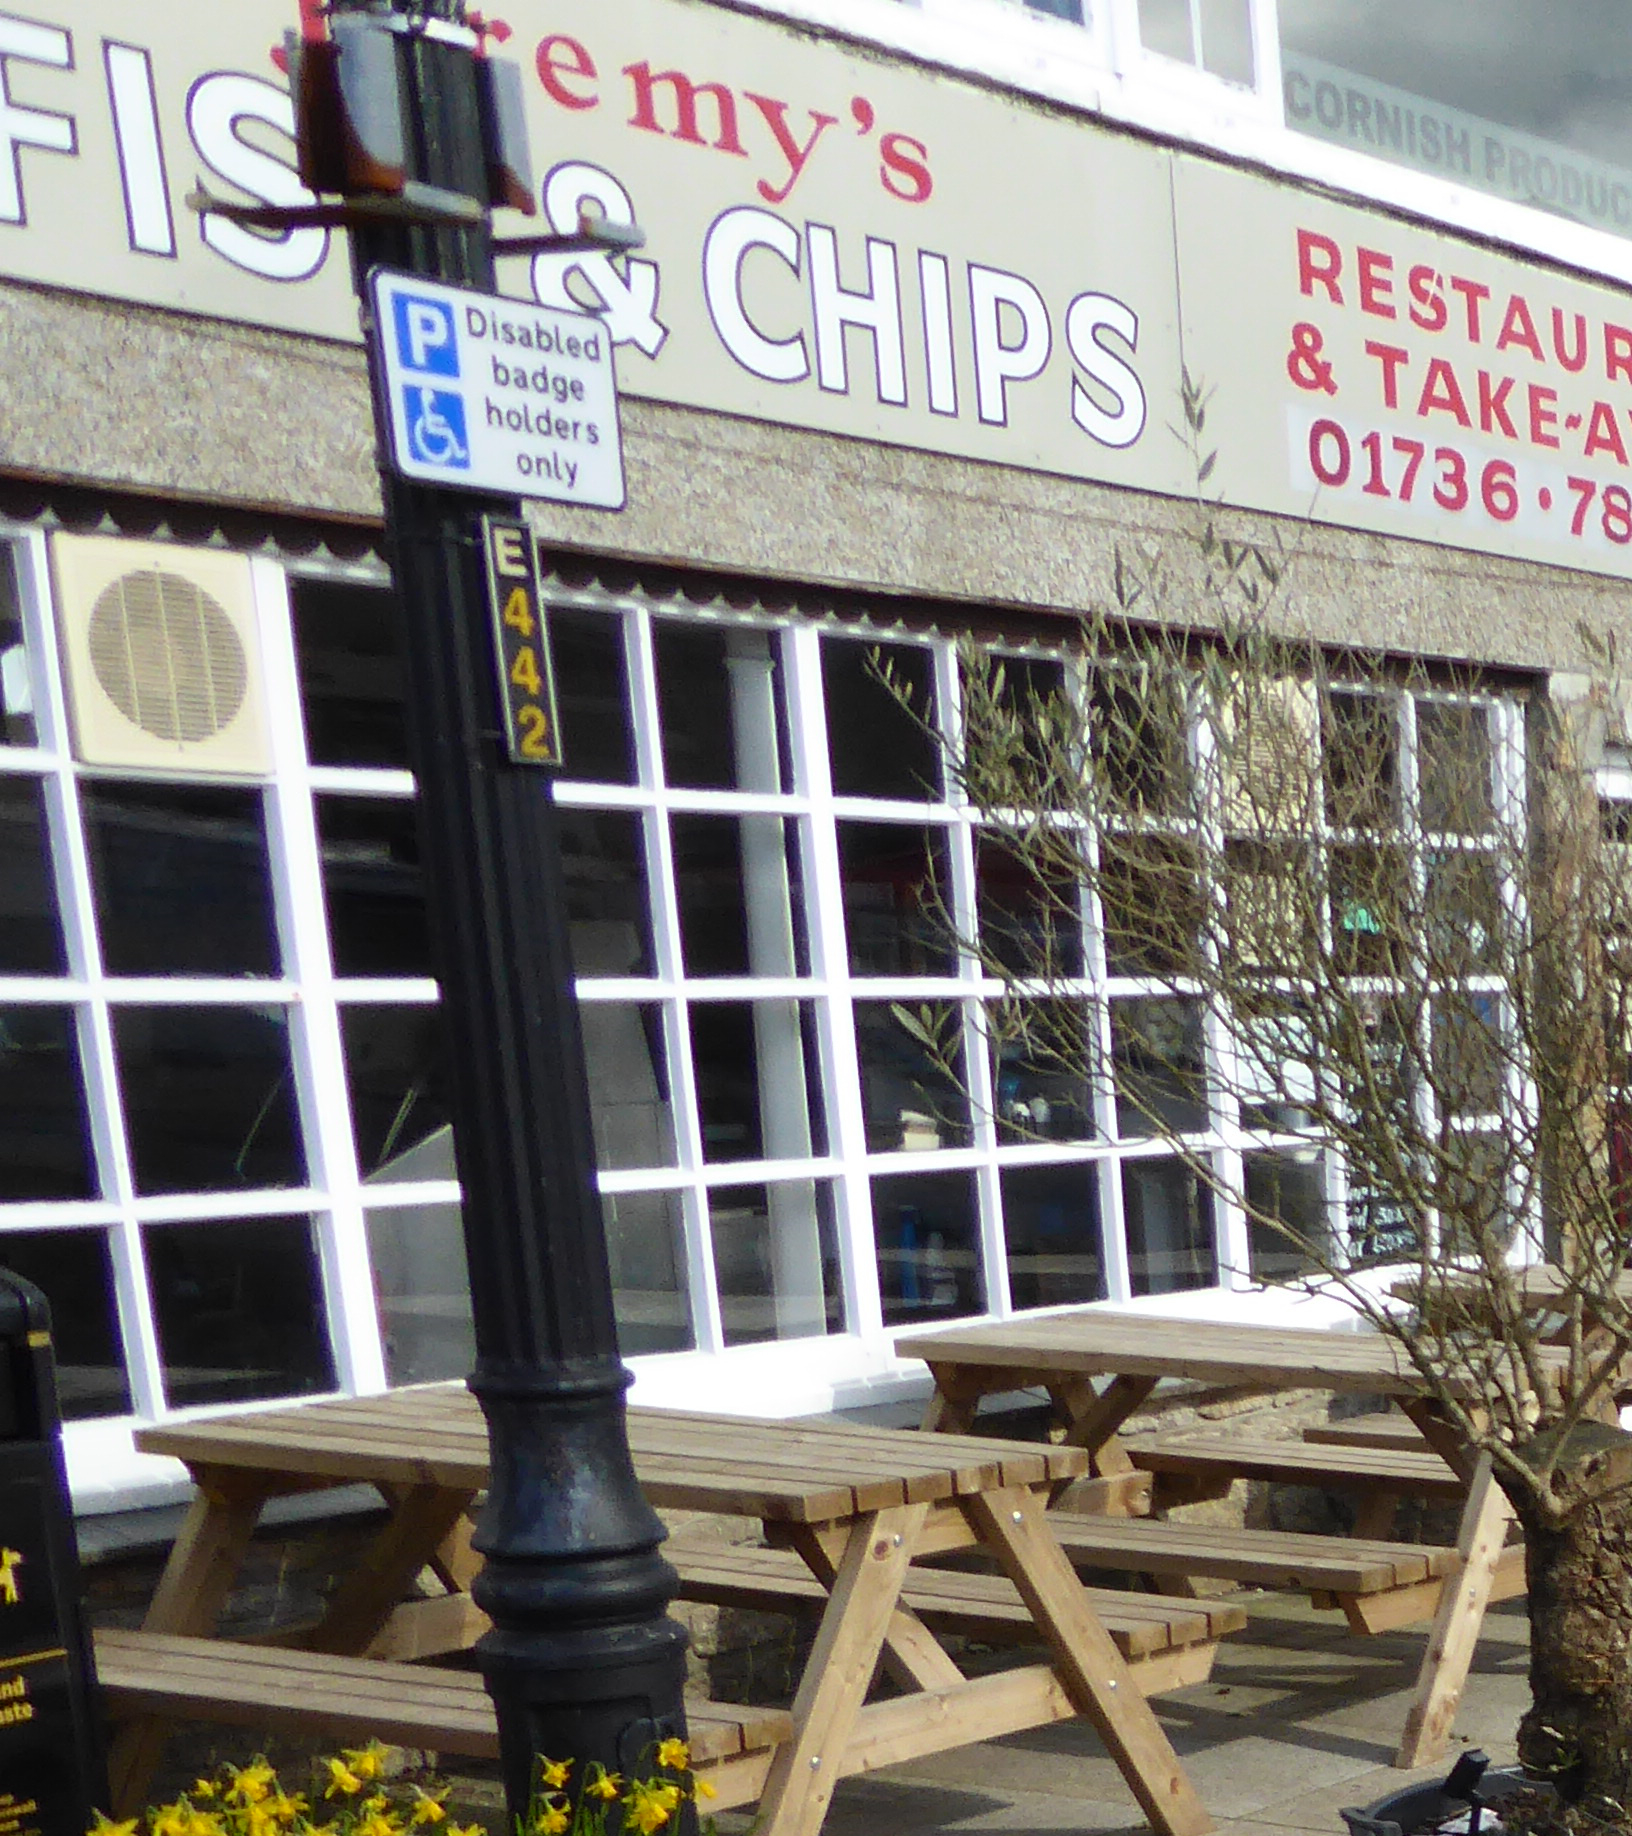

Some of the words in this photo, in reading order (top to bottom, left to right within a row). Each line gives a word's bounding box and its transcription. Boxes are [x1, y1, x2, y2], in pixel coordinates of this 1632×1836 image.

[1283, 70, 1472, 175] CORNISH
[530, 159, 669, 360] &
[701, 203, 1148, 450] CHIPS
[465, 306, 601, 362] Disabled
[1286, 320, 1339, 397] &
[491, 355, 586, 402] badge
[484, 395, 600, 445] holders
[515, 449, 579, 488] only
